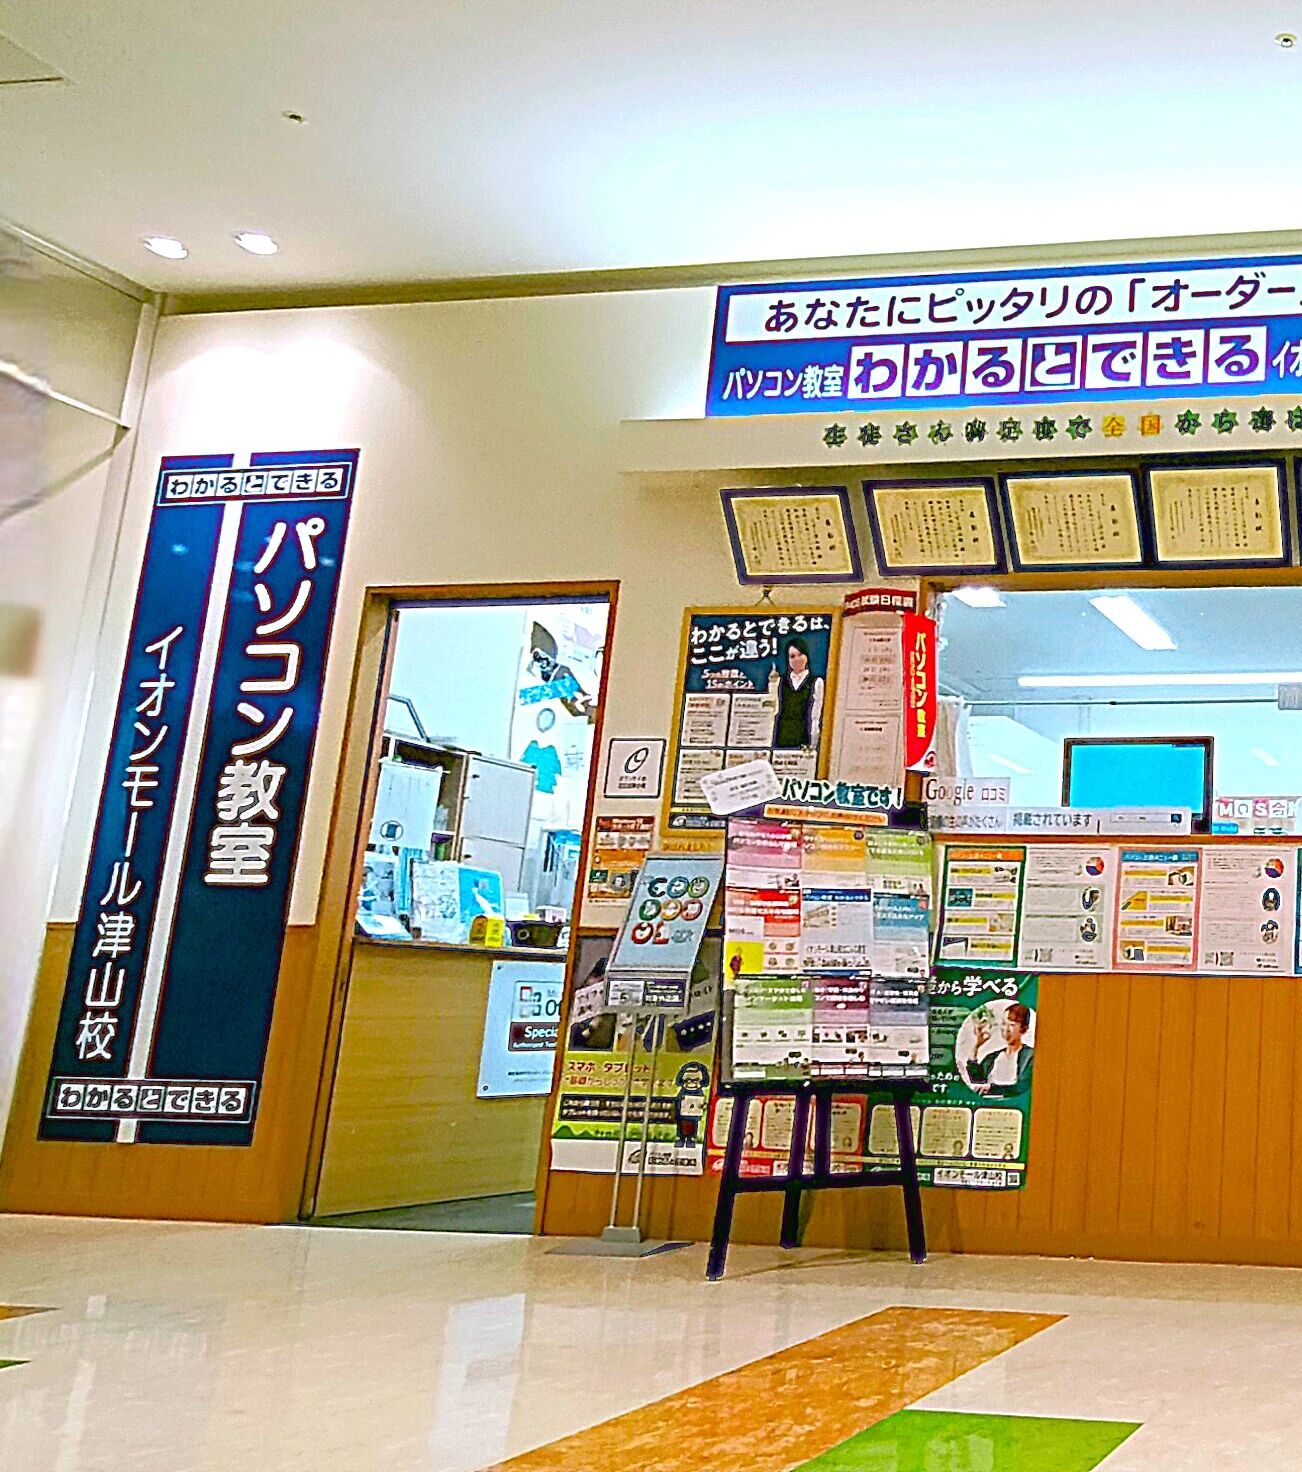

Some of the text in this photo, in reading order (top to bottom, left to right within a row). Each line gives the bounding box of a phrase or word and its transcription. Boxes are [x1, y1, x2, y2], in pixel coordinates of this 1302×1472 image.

[723, 363, 845, 402] パソコン教室
[852, 332, 1263, 396] わかるとできる
[168, 468, 342, 498] わかるとできる
[691, 615, 830, 645] わかるとできるは、
[691, 638, 778, 664] ここが違う!
[204, 517, 326, 885] パソコン教室
[926, 778, 974, 806] Google
[76, 626, 183, 1060] イオンモール津山校
[57, 1083, 245, 1114] わかるとできる
